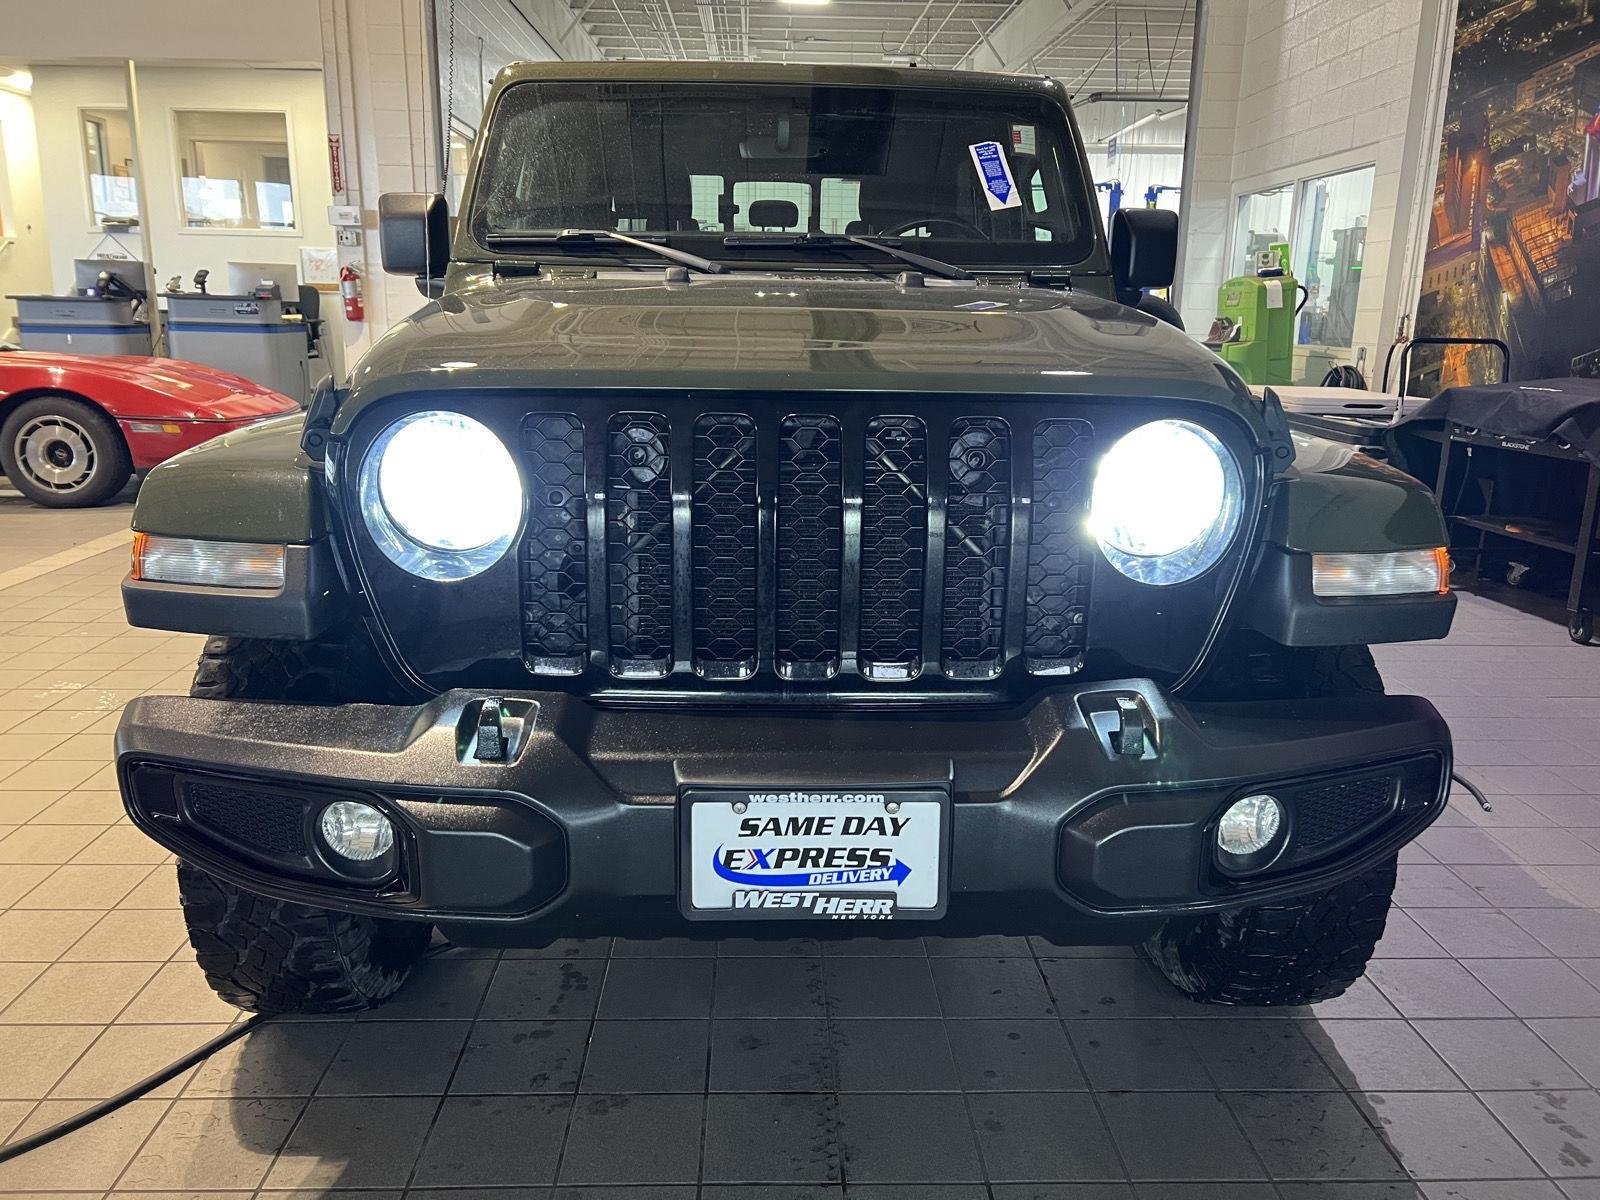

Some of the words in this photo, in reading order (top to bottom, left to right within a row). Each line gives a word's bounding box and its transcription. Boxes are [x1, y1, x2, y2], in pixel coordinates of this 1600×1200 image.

[1502, 441, 1530, 450] BLACKSTONE
[749, 793, 884, 803] westherr.com
[738, 816, 836, 837] SAME
[840, 816, 912, 837] DAY
[723, 848, 893, 869] EXPRESS
[808, 867, 894, 885] DELIVERY
